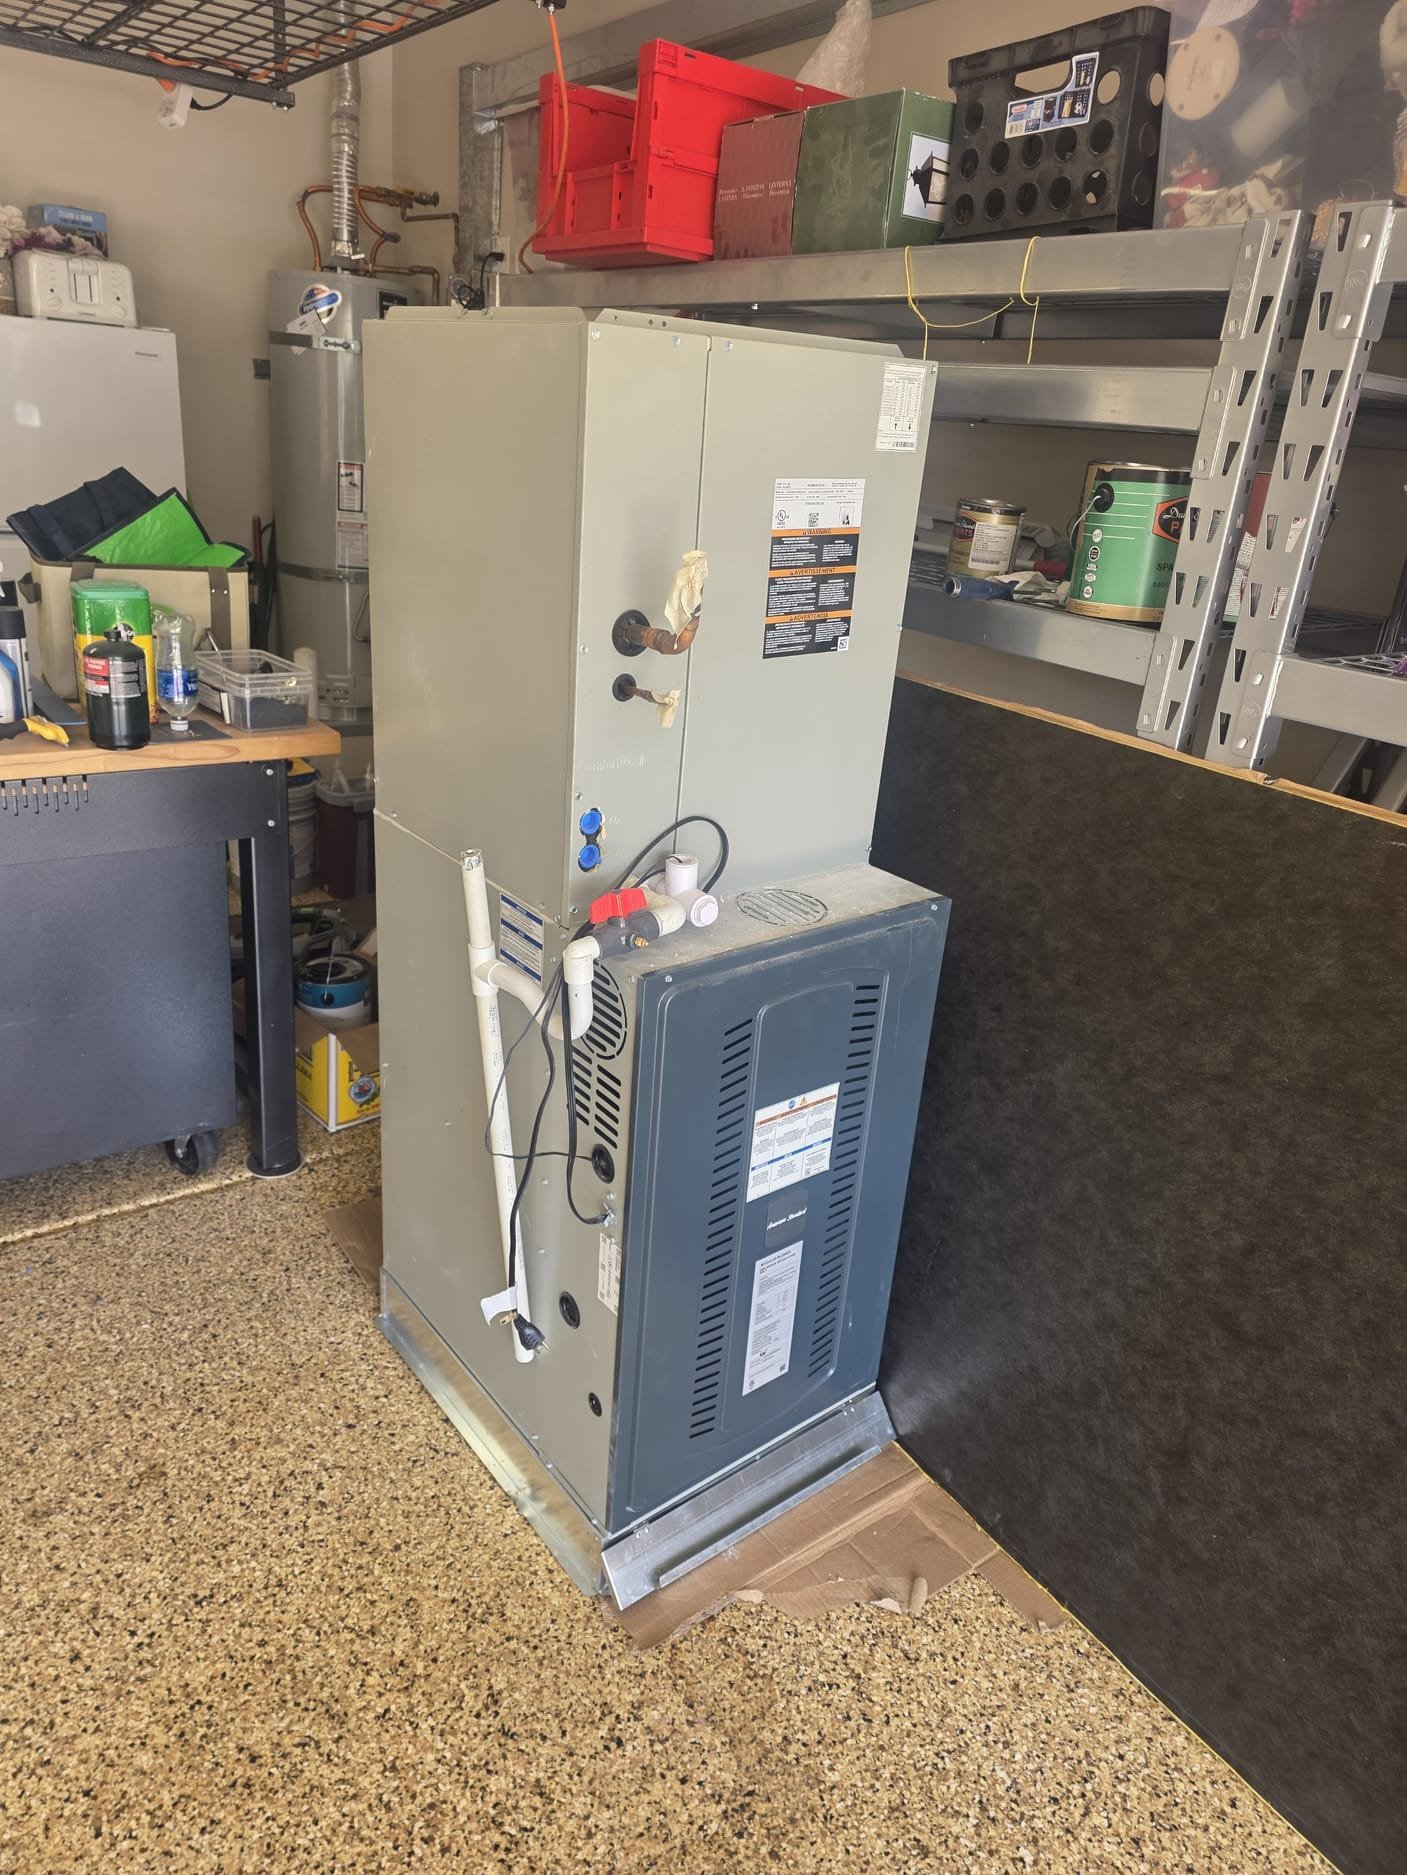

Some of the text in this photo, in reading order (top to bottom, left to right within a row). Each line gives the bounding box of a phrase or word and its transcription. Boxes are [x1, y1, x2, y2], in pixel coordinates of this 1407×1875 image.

[807, 528, 832, 536] WARNING
[794, 567, 836, 576] AVERTISSEMENT
[1156, 562, 1174, 572] SPA
[793, 612, 829, 622] ADVERTENCIA
